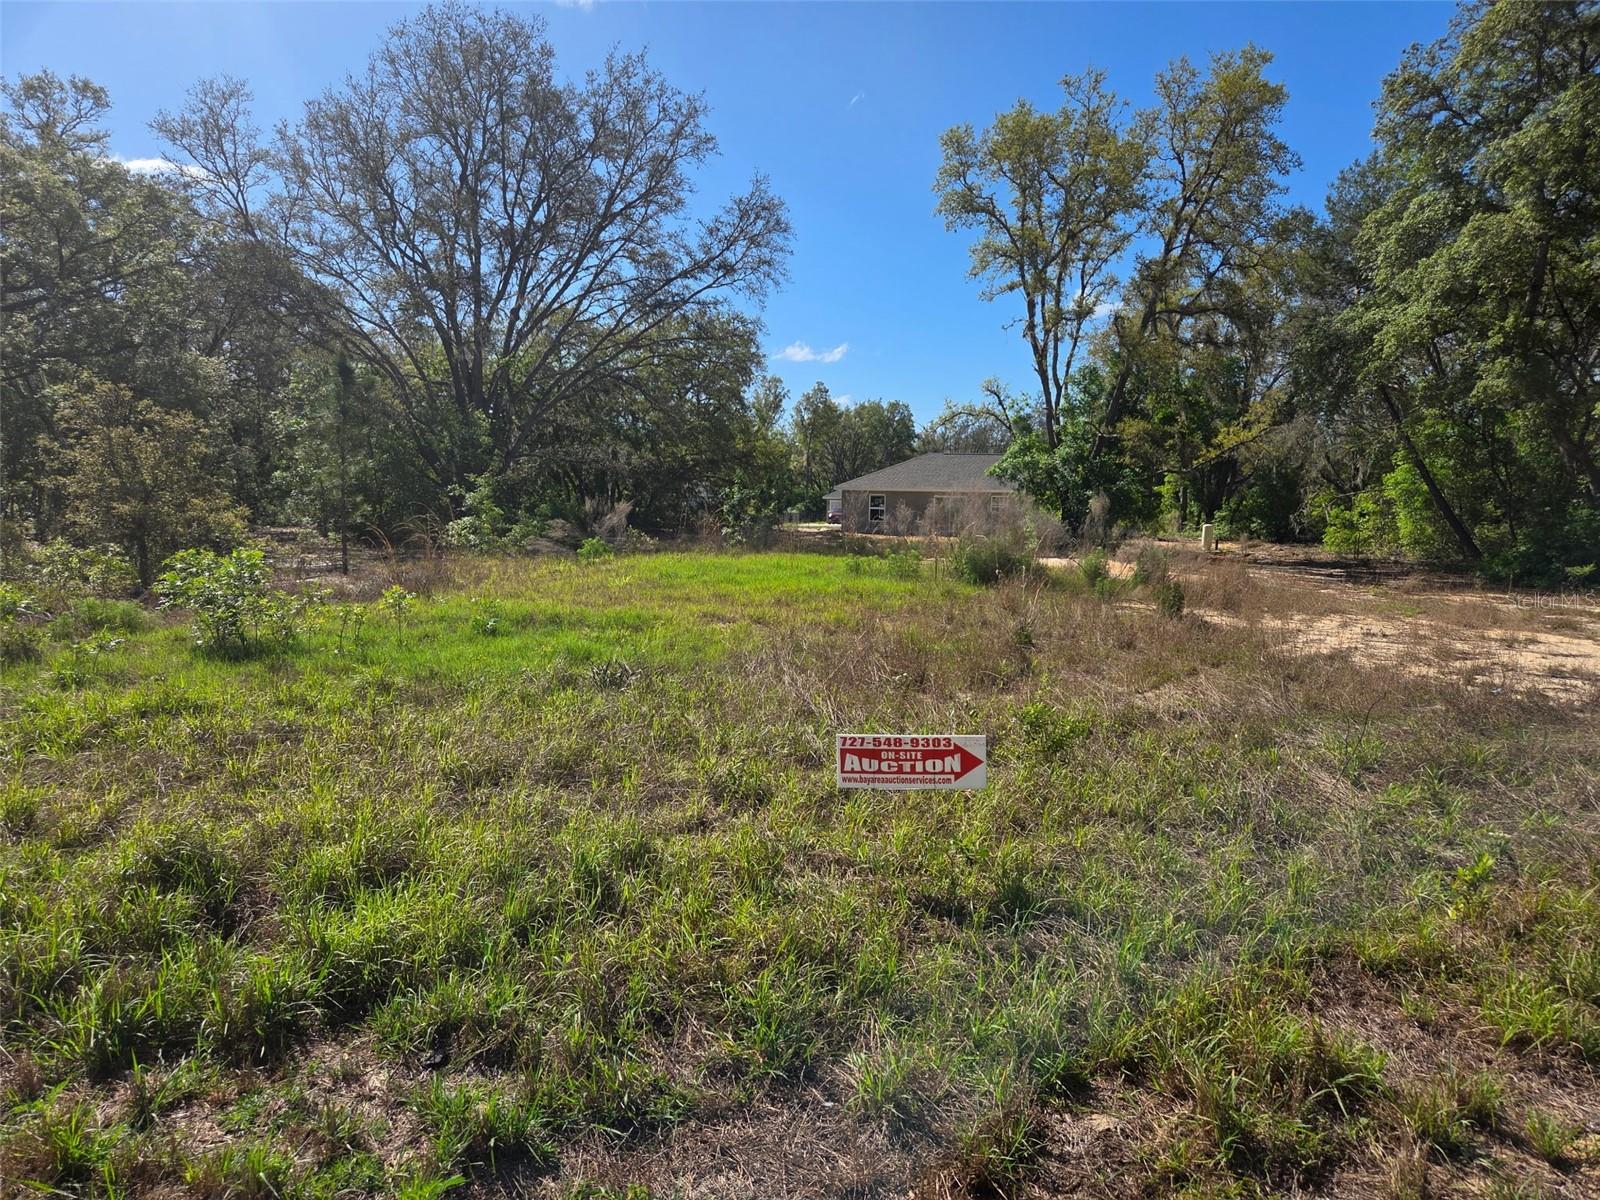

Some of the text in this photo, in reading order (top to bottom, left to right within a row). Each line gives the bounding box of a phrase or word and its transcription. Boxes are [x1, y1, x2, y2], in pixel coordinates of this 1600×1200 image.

[840, 736, 952, 748] 727-548-9303
[881, 751, 923, 760] ON-SITE
[843, 752, 961, 773] AUCTION
[841, 775, 952, 785] www.bayareaauctionservices.com
